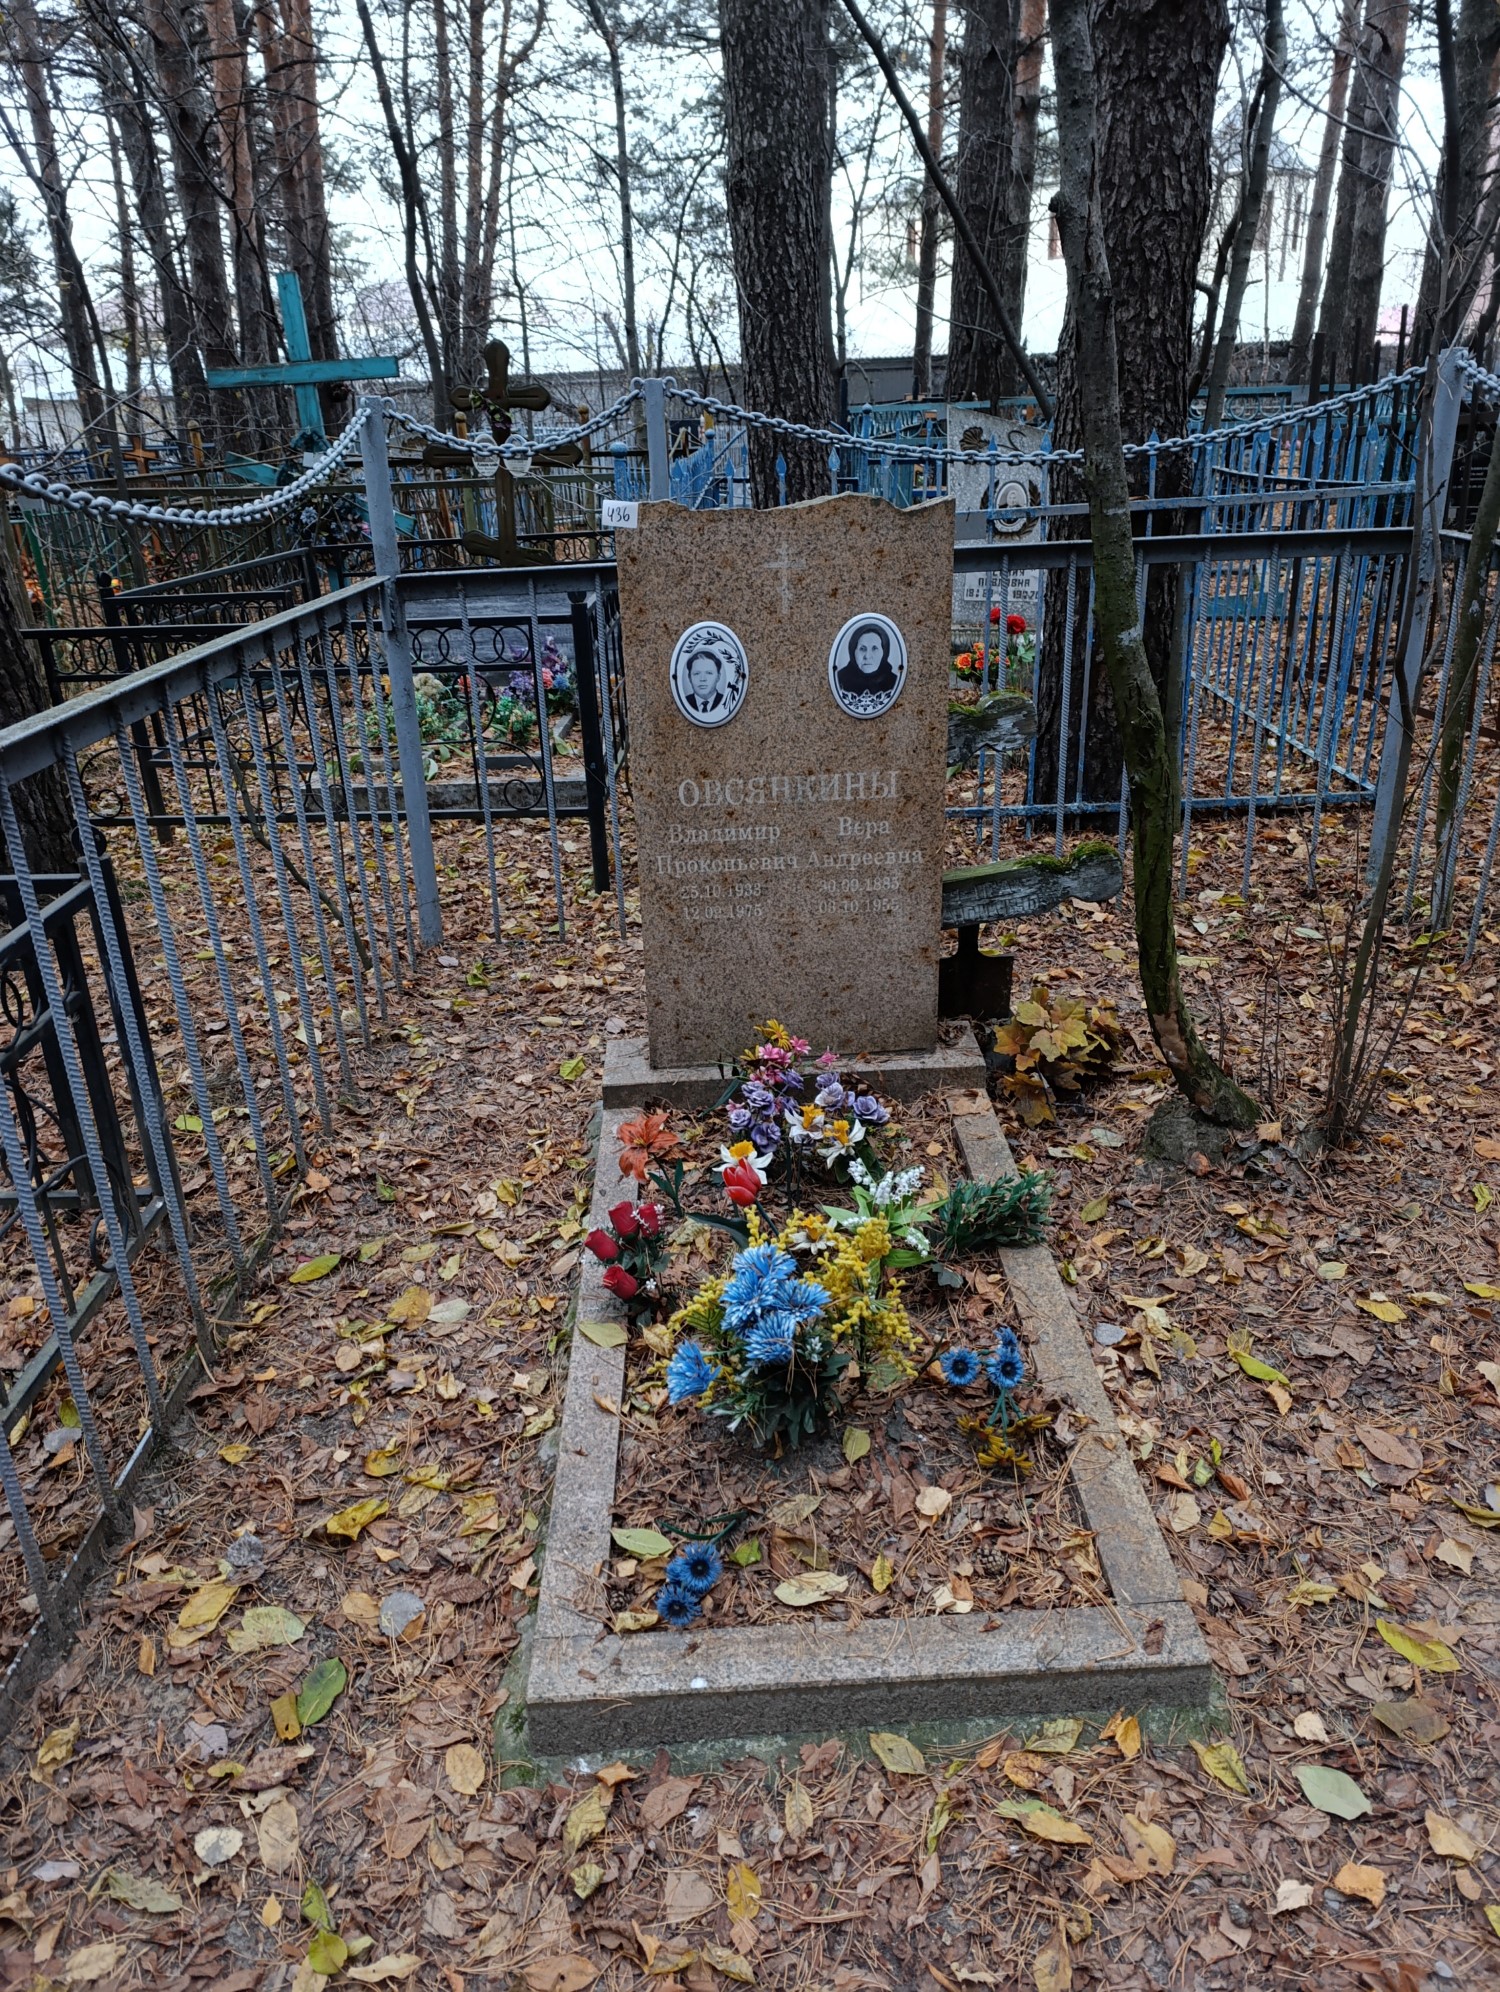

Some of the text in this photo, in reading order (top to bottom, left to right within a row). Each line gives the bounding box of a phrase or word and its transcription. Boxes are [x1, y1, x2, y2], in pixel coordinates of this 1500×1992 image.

[607, 506, 630, 523] 436
[678, 770, 900, 808] ОВСЯНКИНЫ
[668, 815, 890, 845] Владимир Вера
[655, 849, 922, 878] Прокопьевич Андреевна
